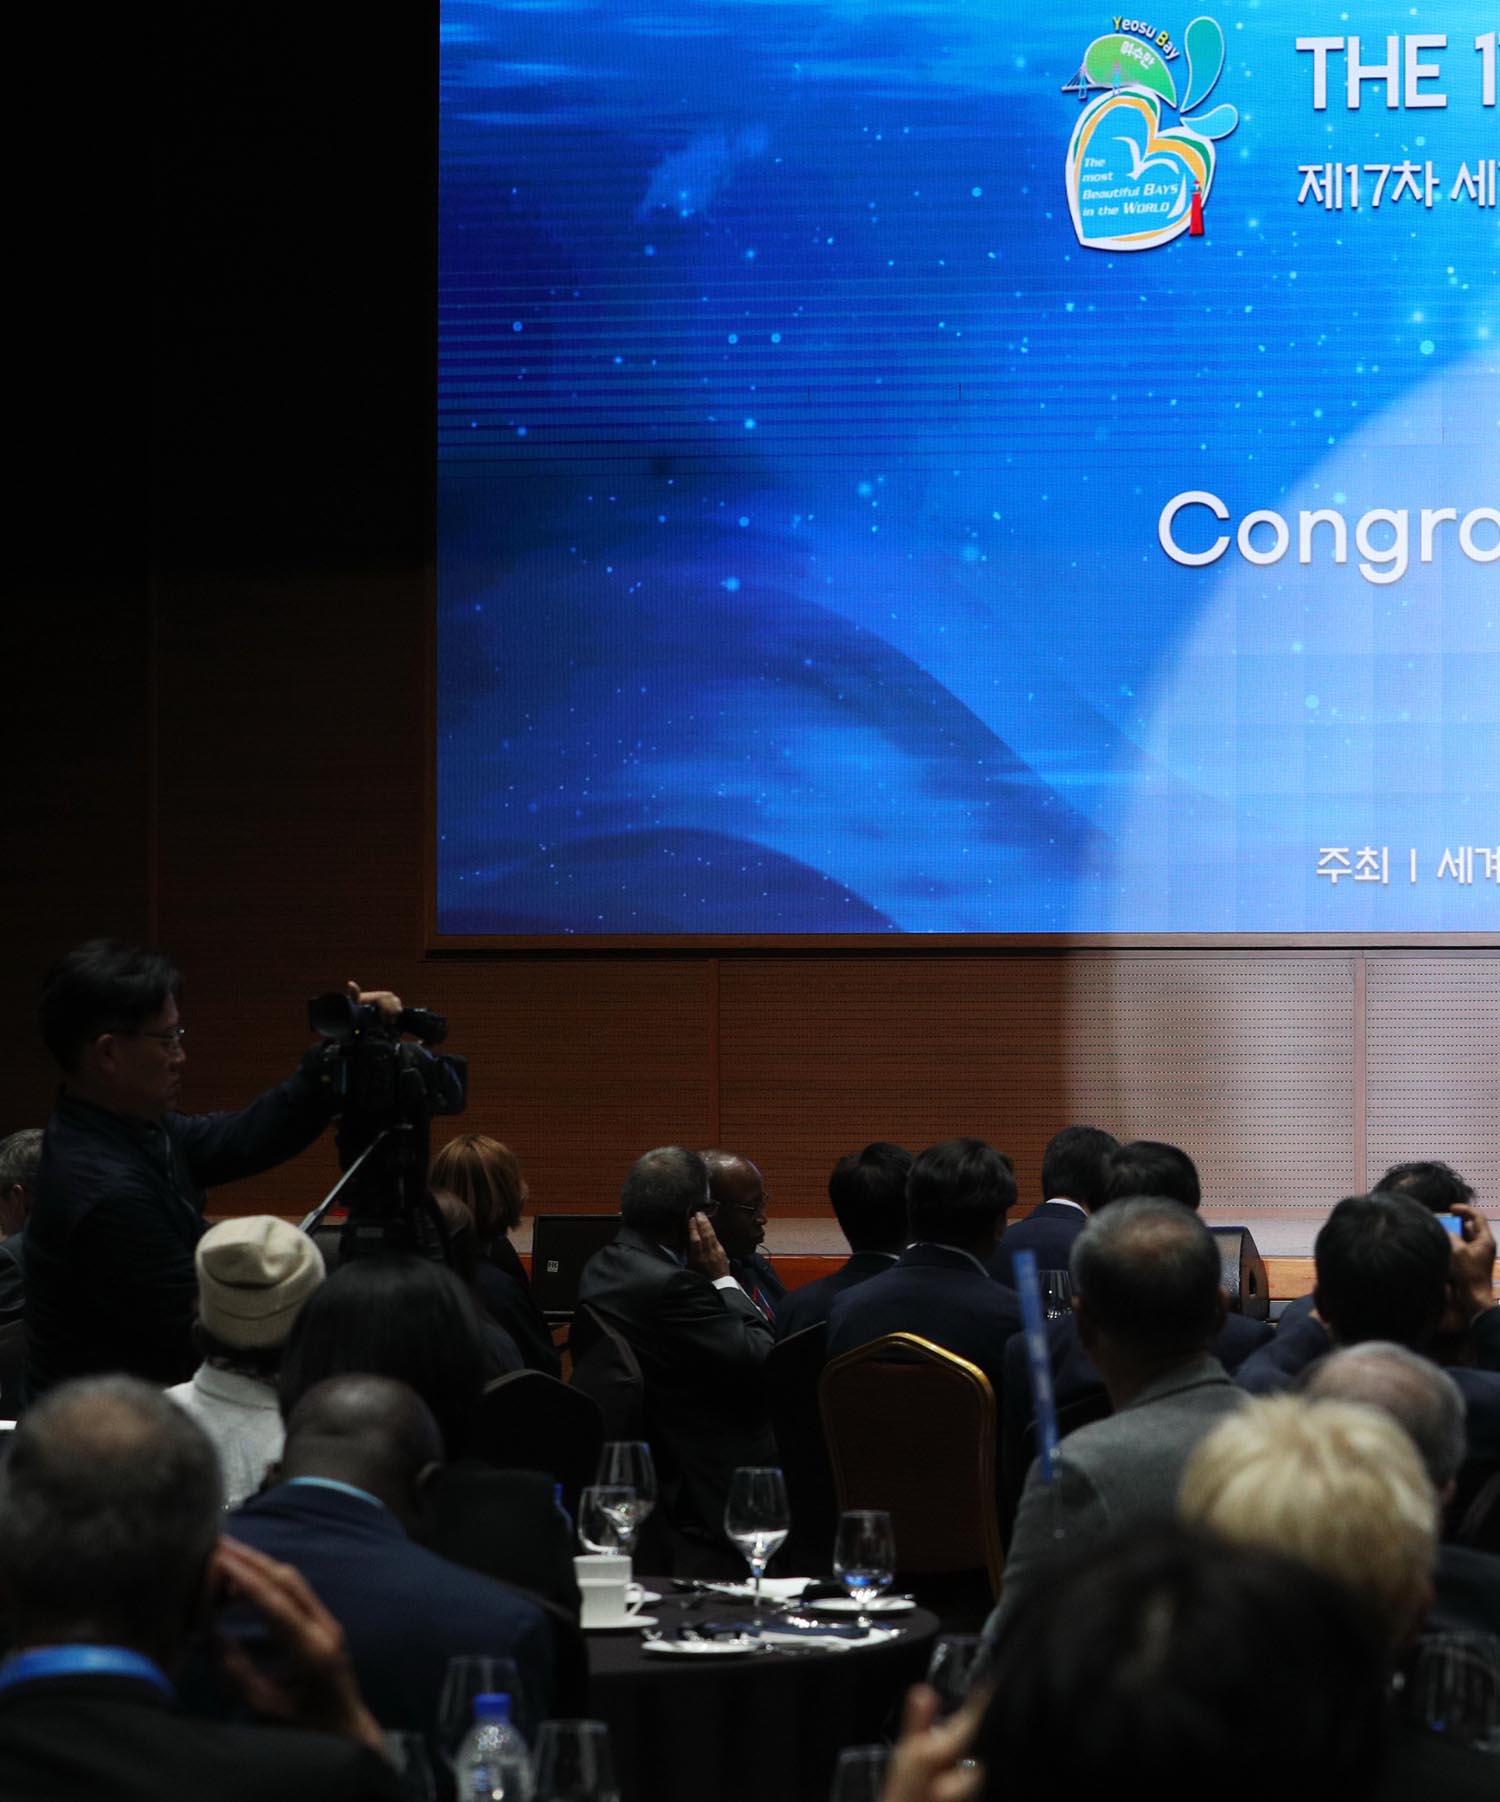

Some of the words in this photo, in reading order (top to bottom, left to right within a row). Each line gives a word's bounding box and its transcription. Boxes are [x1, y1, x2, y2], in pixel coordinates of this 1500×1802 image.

[1113, 15, 1157, 39] Yeosu
[1155, 30, 1181, 61] Bay
[1295, 33, 1448, 110] THE
[1084, 157, 1106, 168] The
[1082, 172, 1113, 183] most
[1297, 159, 1440, 210] 제17차
[1082, 186, 1140, 200] Beautiful
[1082, 206, 1095, 217] in
[1097, 206, 1120, 216] the
[1316, 846, 1389, 885] 주최
